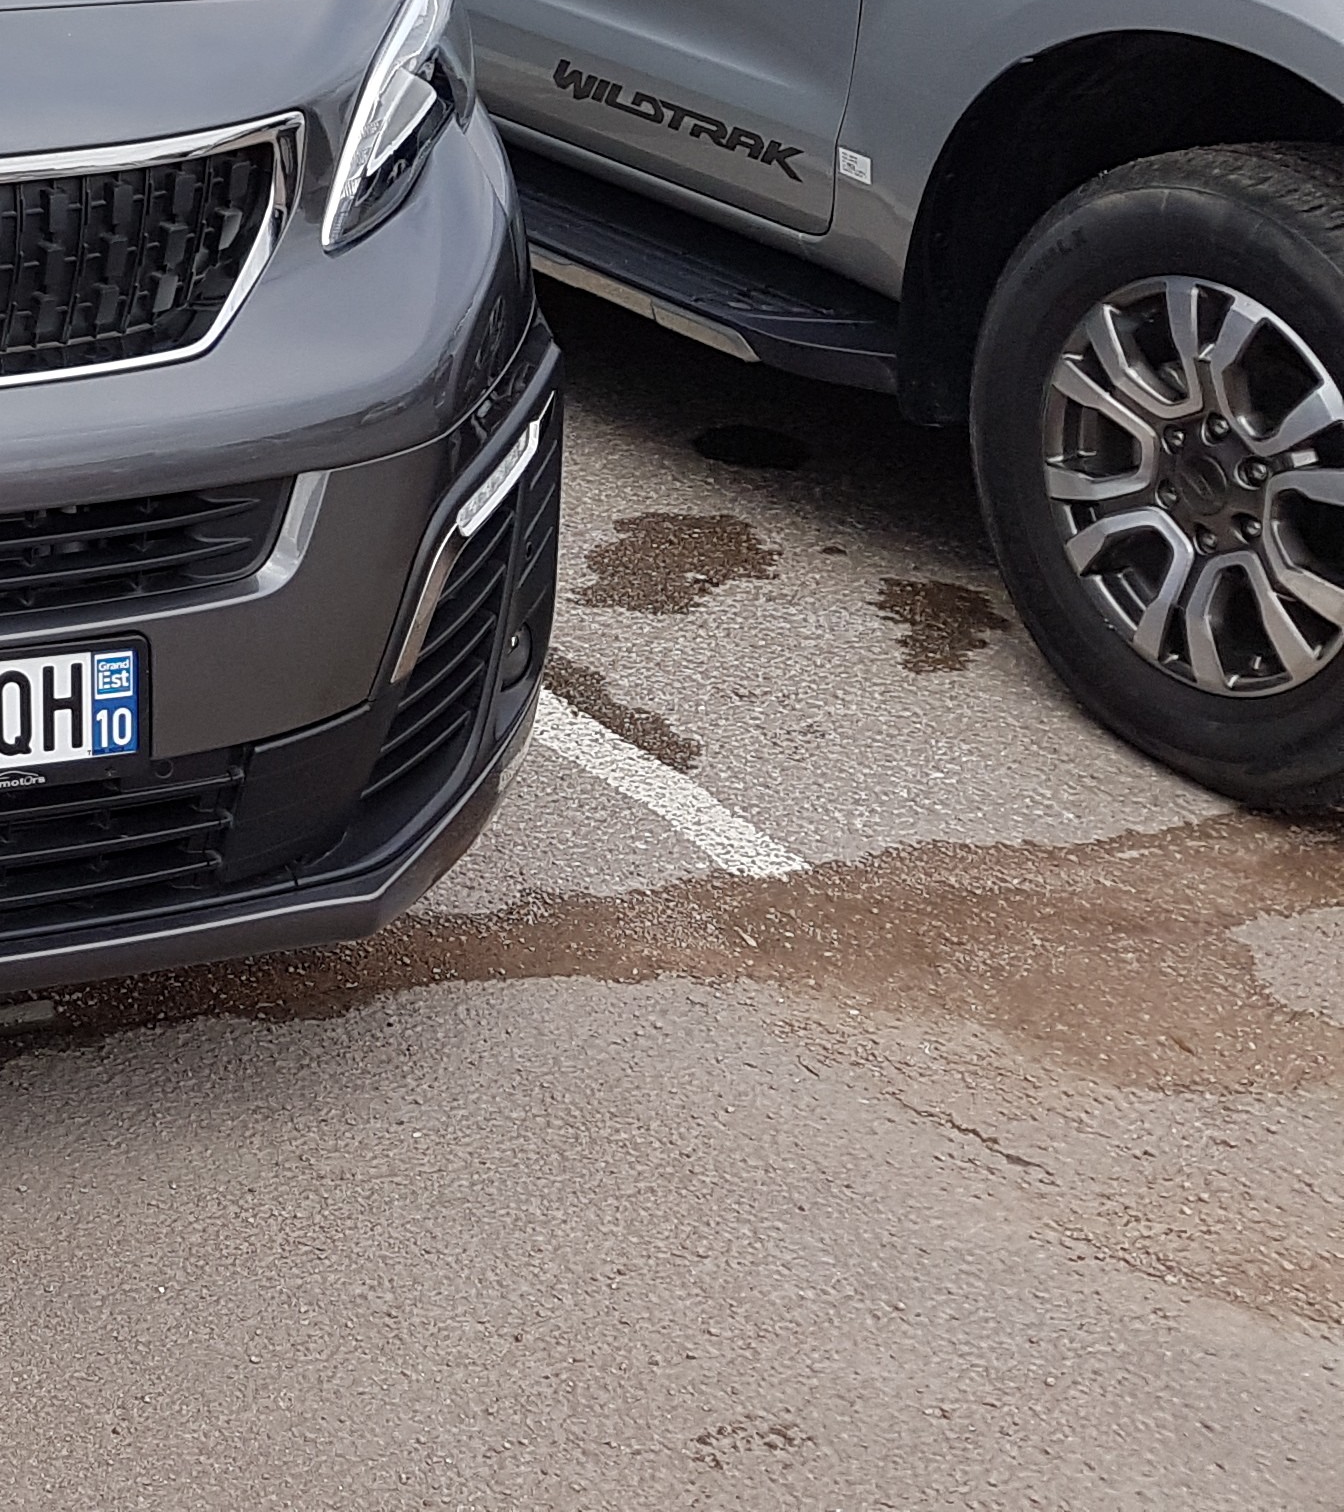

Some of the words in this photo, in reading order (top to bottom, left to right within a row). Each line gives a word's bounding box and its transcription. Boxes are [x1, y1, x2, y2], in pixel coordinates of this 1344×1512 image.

[552, 58, 805, 184] WILDTRAK
[98, 659, 130, 671] Grand
[98, 670, 130, 689] Est
[96, 707, 132, 748] 10
